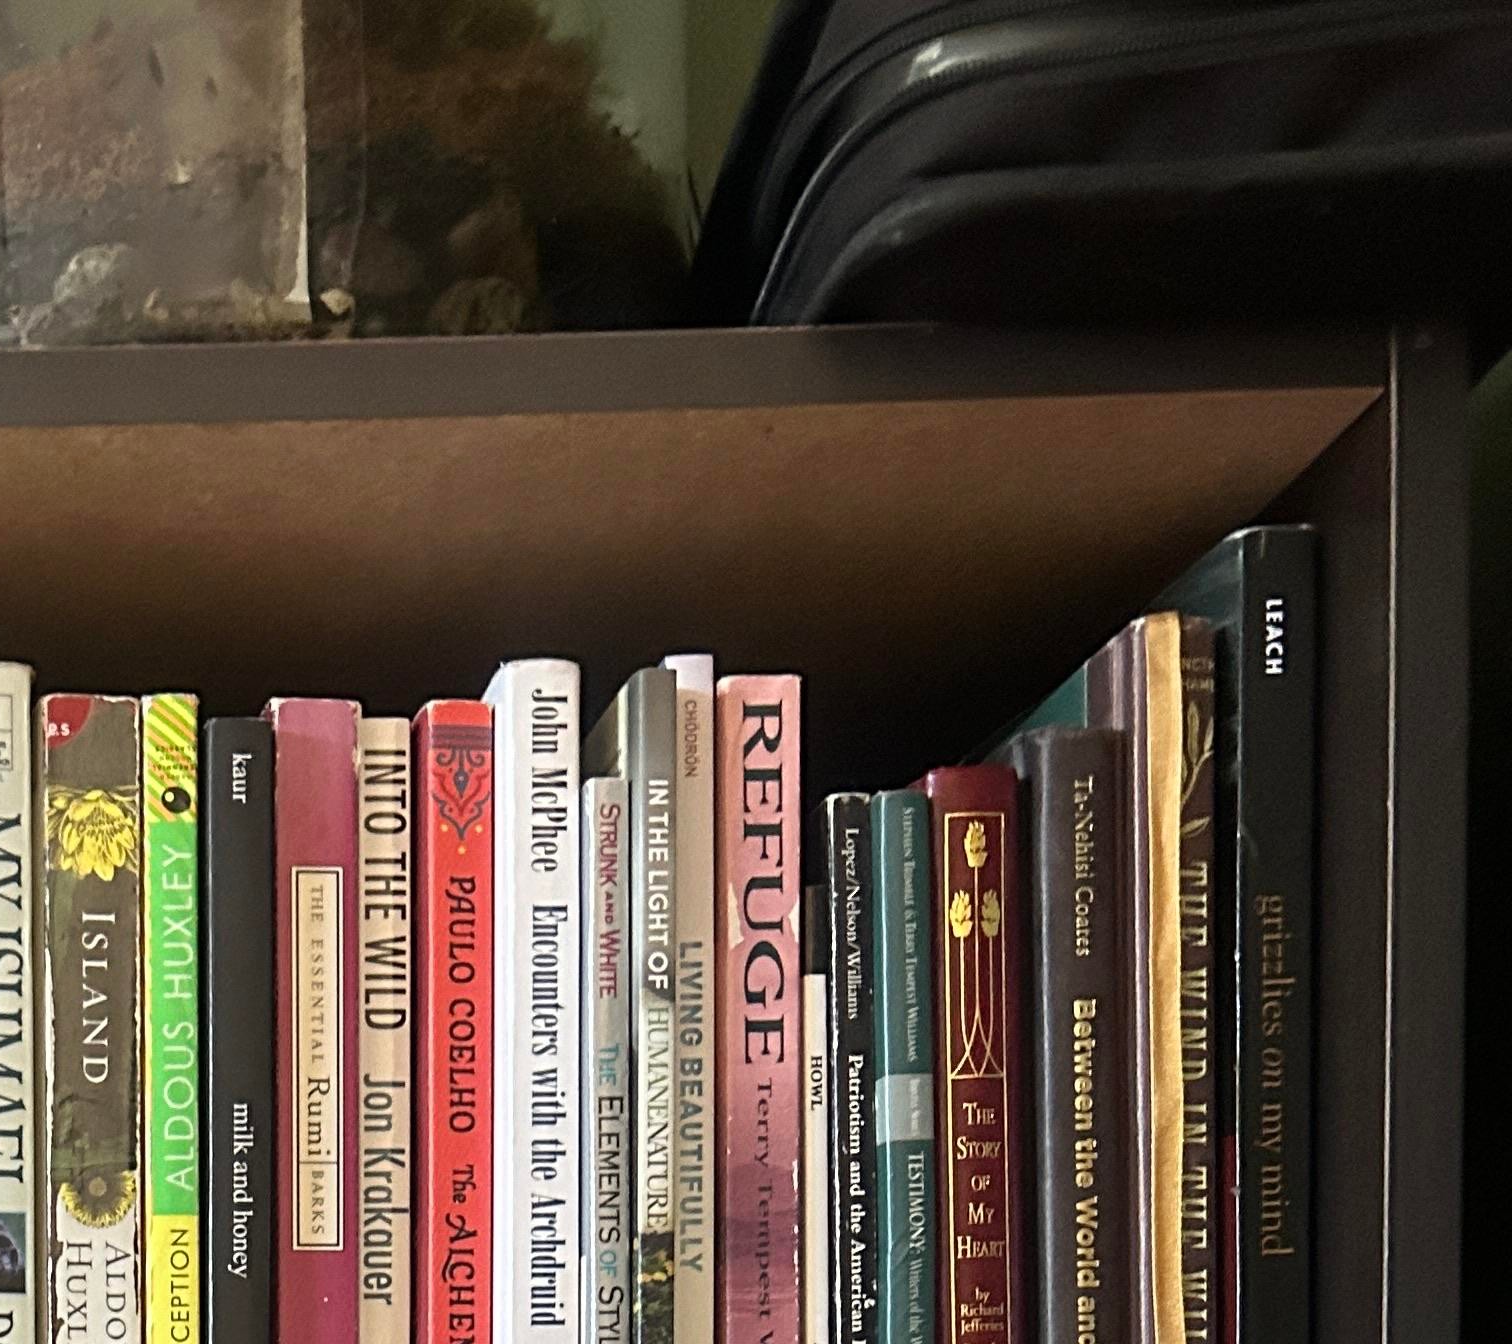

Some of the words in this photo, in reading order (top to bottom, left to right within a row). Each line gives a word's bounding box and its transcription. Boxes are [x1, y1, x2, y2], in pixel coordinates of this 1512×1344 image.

[1265, 598, 1283, 674] LEACH
[530, 688, 569, 754] John
[233, 753, 251, 804] kaur
[364, 749, 407, 836] INTO
[530, 767, 569, 872] McPhee
[364, 851, 407, 920] THE
[600, 803, 620, 886] STRUNK
[444, 876, 476, 984] PAULO
[605, 891, 614, 925] AND
[842, 828, 862, 1019] Lopez/Nelson/Williams
[1075, 886, 1094, 956] Coates
[364, 936, 407, 1030] WILD
[531, 904, 568, 1056] Encounters
[600, 929, 620, 999] WHITE
[680, 940, 703, 1046] LIVING
[363, 1074, 405, 1133] Jon
[449, 999, 476, 1134] COELHO
[532, 1068, 568, 1124] with
[810, 1055, 823, 1110] HOWL
[848, 1055, 863, 1153] Patriotism
[531, 1138, 566, 1181] the
[680, 1057, 703, 1273] BEAUTIFULLY
[849, 1161, 863, 1196] and
[362, 1147, 409, 1305] Krakauer
[530, 1192, 566, 1327] Archdruid
[850, 1203, 865, 1233] the
[850, 1239, 867, 1332] American
